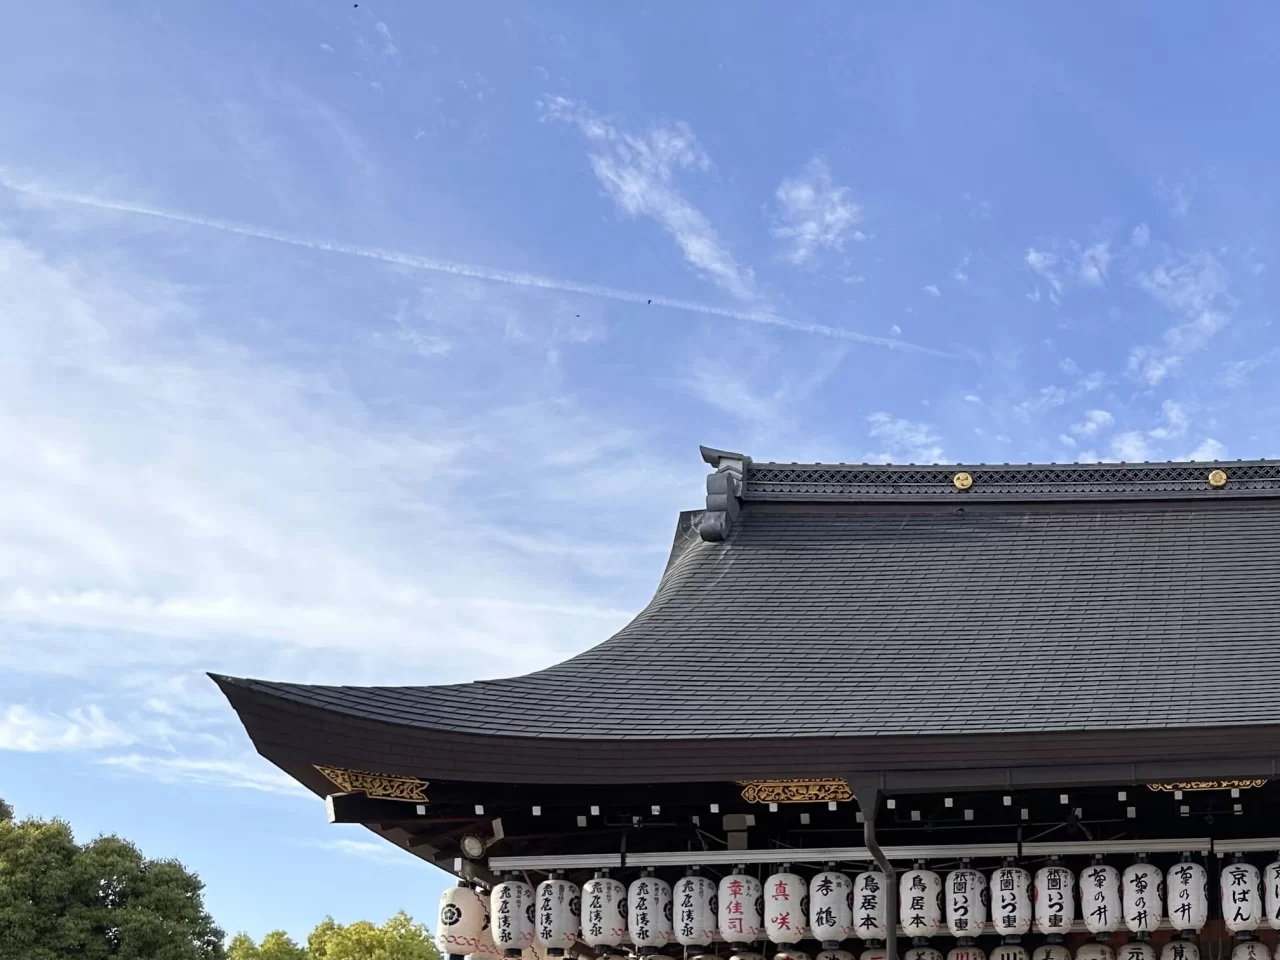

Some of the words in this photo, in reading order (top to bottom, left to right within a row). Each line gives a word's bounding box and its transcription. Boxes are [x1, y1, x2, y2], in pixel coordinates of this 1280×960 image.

[771, 880, 790, 931] 真咲
[815, 876, 836, 928] 孝鶴
[859, 875, 879, 930] 鳥居本
[909, 875, 927, 928] 鳥居本
[953, 872, 968, 931] 祇園いづ重
[1000, 870, 1016, 928] 祇園いづ重
[1047, 869, 1063, 927] 祇園いづ重
[1229, 867, 1251, 922] 京ばん
